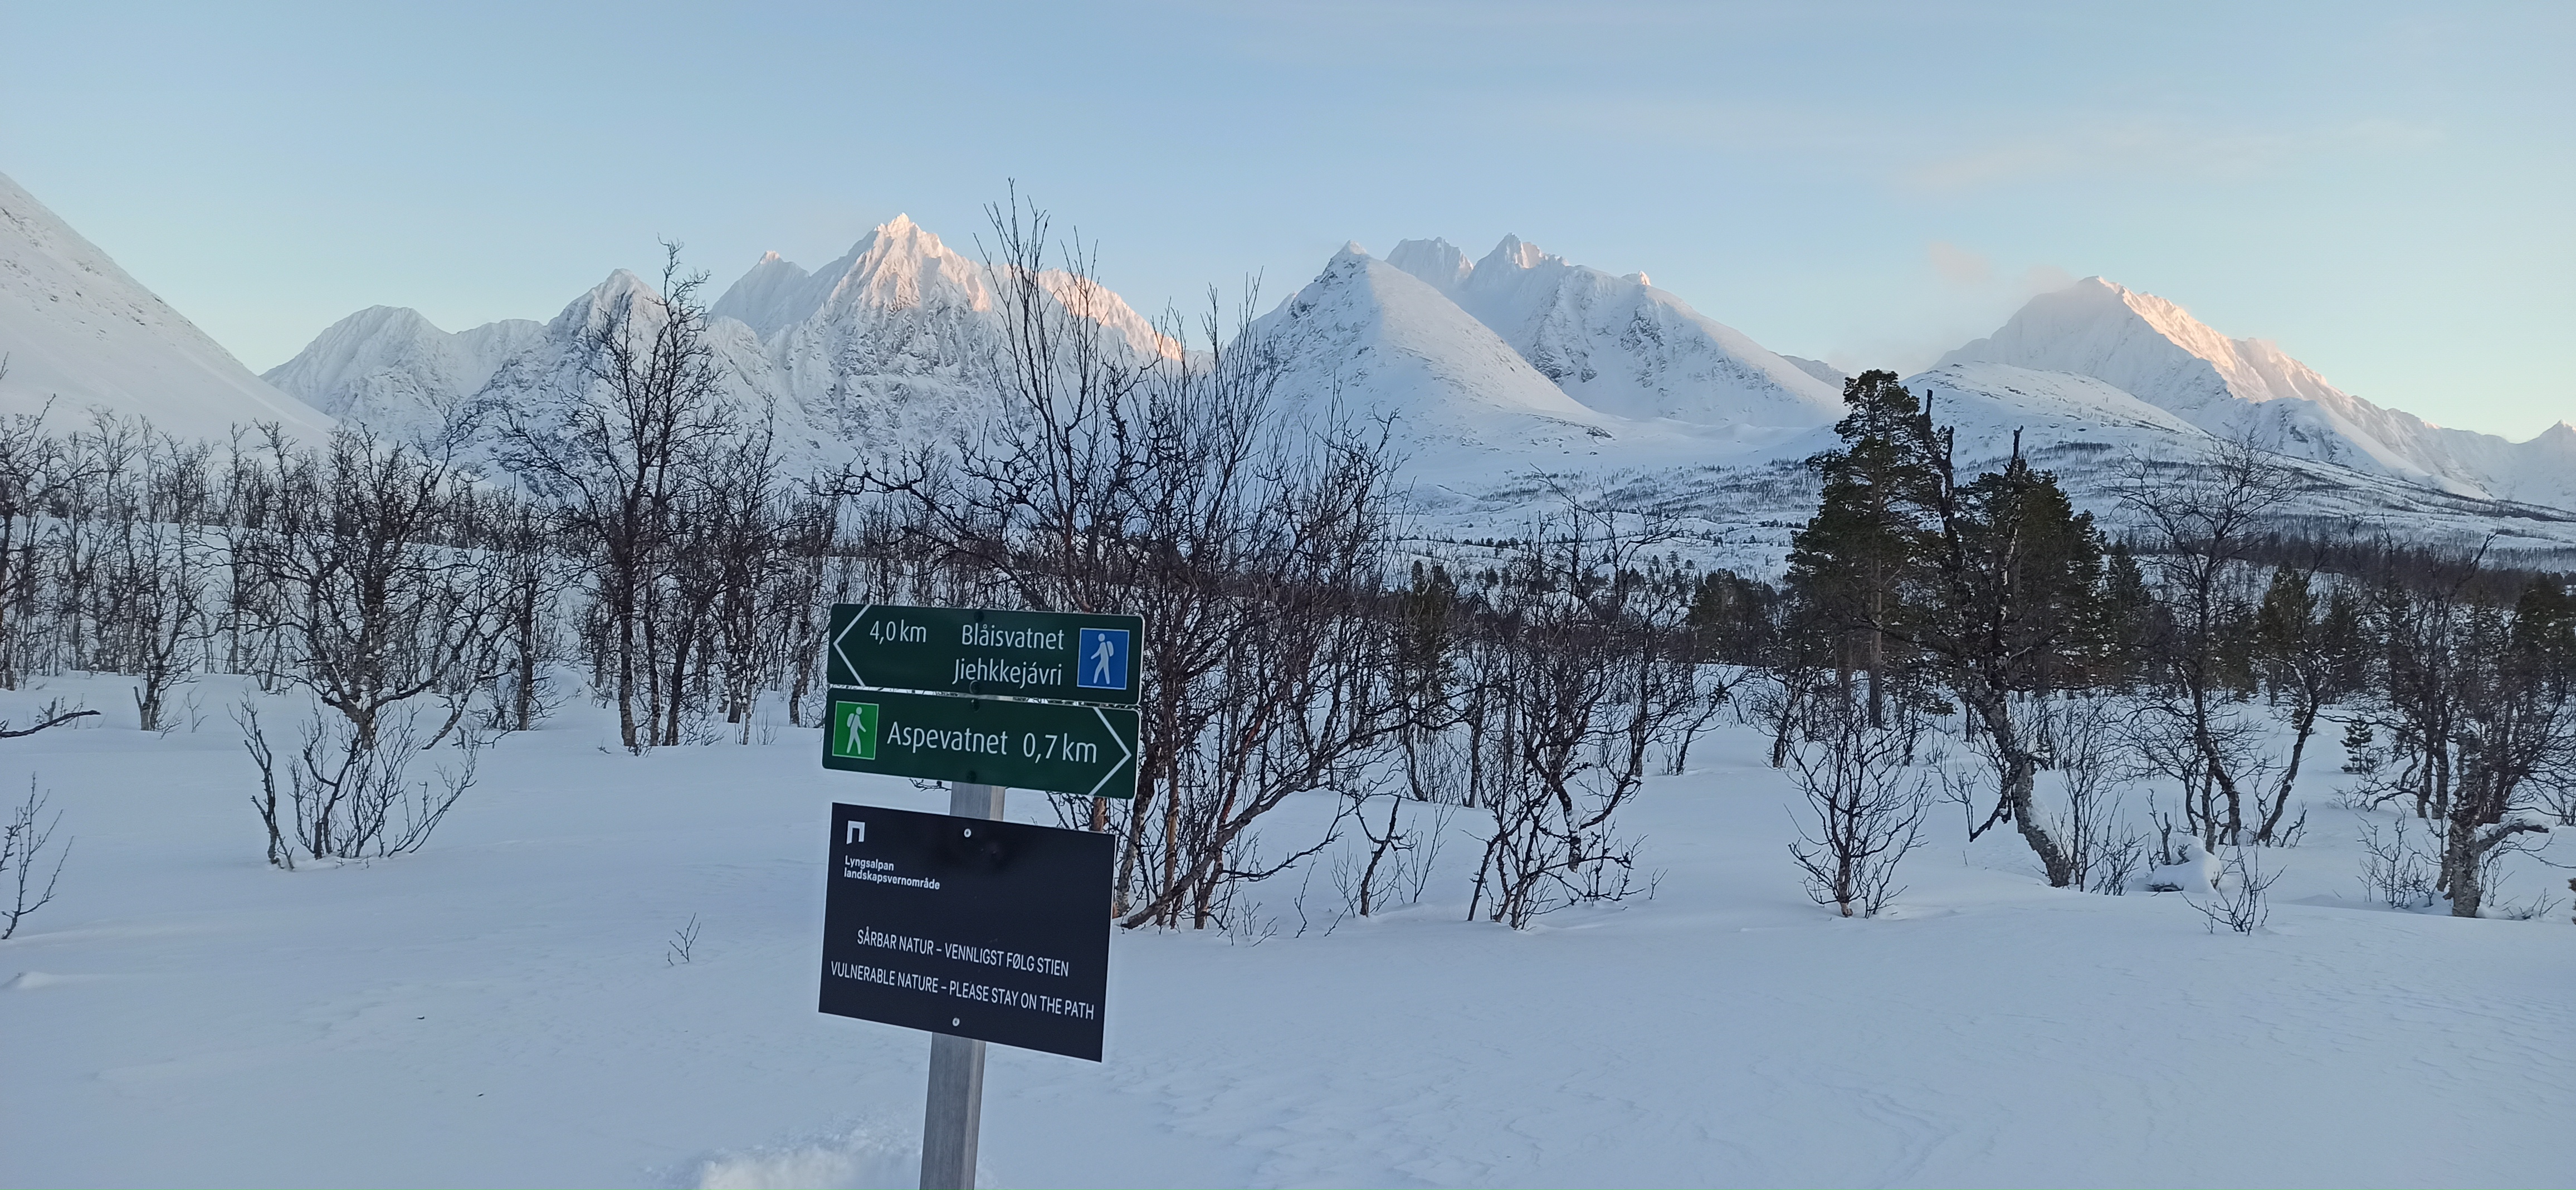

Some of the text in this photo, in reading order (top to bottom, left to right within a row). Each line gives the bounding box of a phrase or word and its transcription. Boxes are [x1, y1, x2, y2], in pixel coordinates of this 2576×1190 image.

[870, 619, 926, 645] 4,0 km
[962, 622, 1065, 650] Blåisvatnet
[952, 657, 1062, 689] Jiehkkejávri
[887, 721, 1097, 763] Aspevatnet 0,7 km
[845, 855, 894, 871] Lyngsalpan
[844, 867, 940, 890] landskapsvernområde
[857, 926, 897, 949] SÅRBAR
[899, 935, 934, 955] NATUR
[945, 943, 1004, 966] VENNLIGST
[1006, 952, 1035, 972] FØLG
[1037, 957, 1069, 977] STIEN
[831, 960, 896, 986] VULNERABLE
[897, 972, 939, 993] NATURE
[949, 980, 989, 1002] PLEASE
[991, 987, 1019, 1006] STAY
[1021, 992, 1037, 1010] ON
[1040, 995, 1062, 1015] THE
[1064, 999, 1094, 1020] PATH
